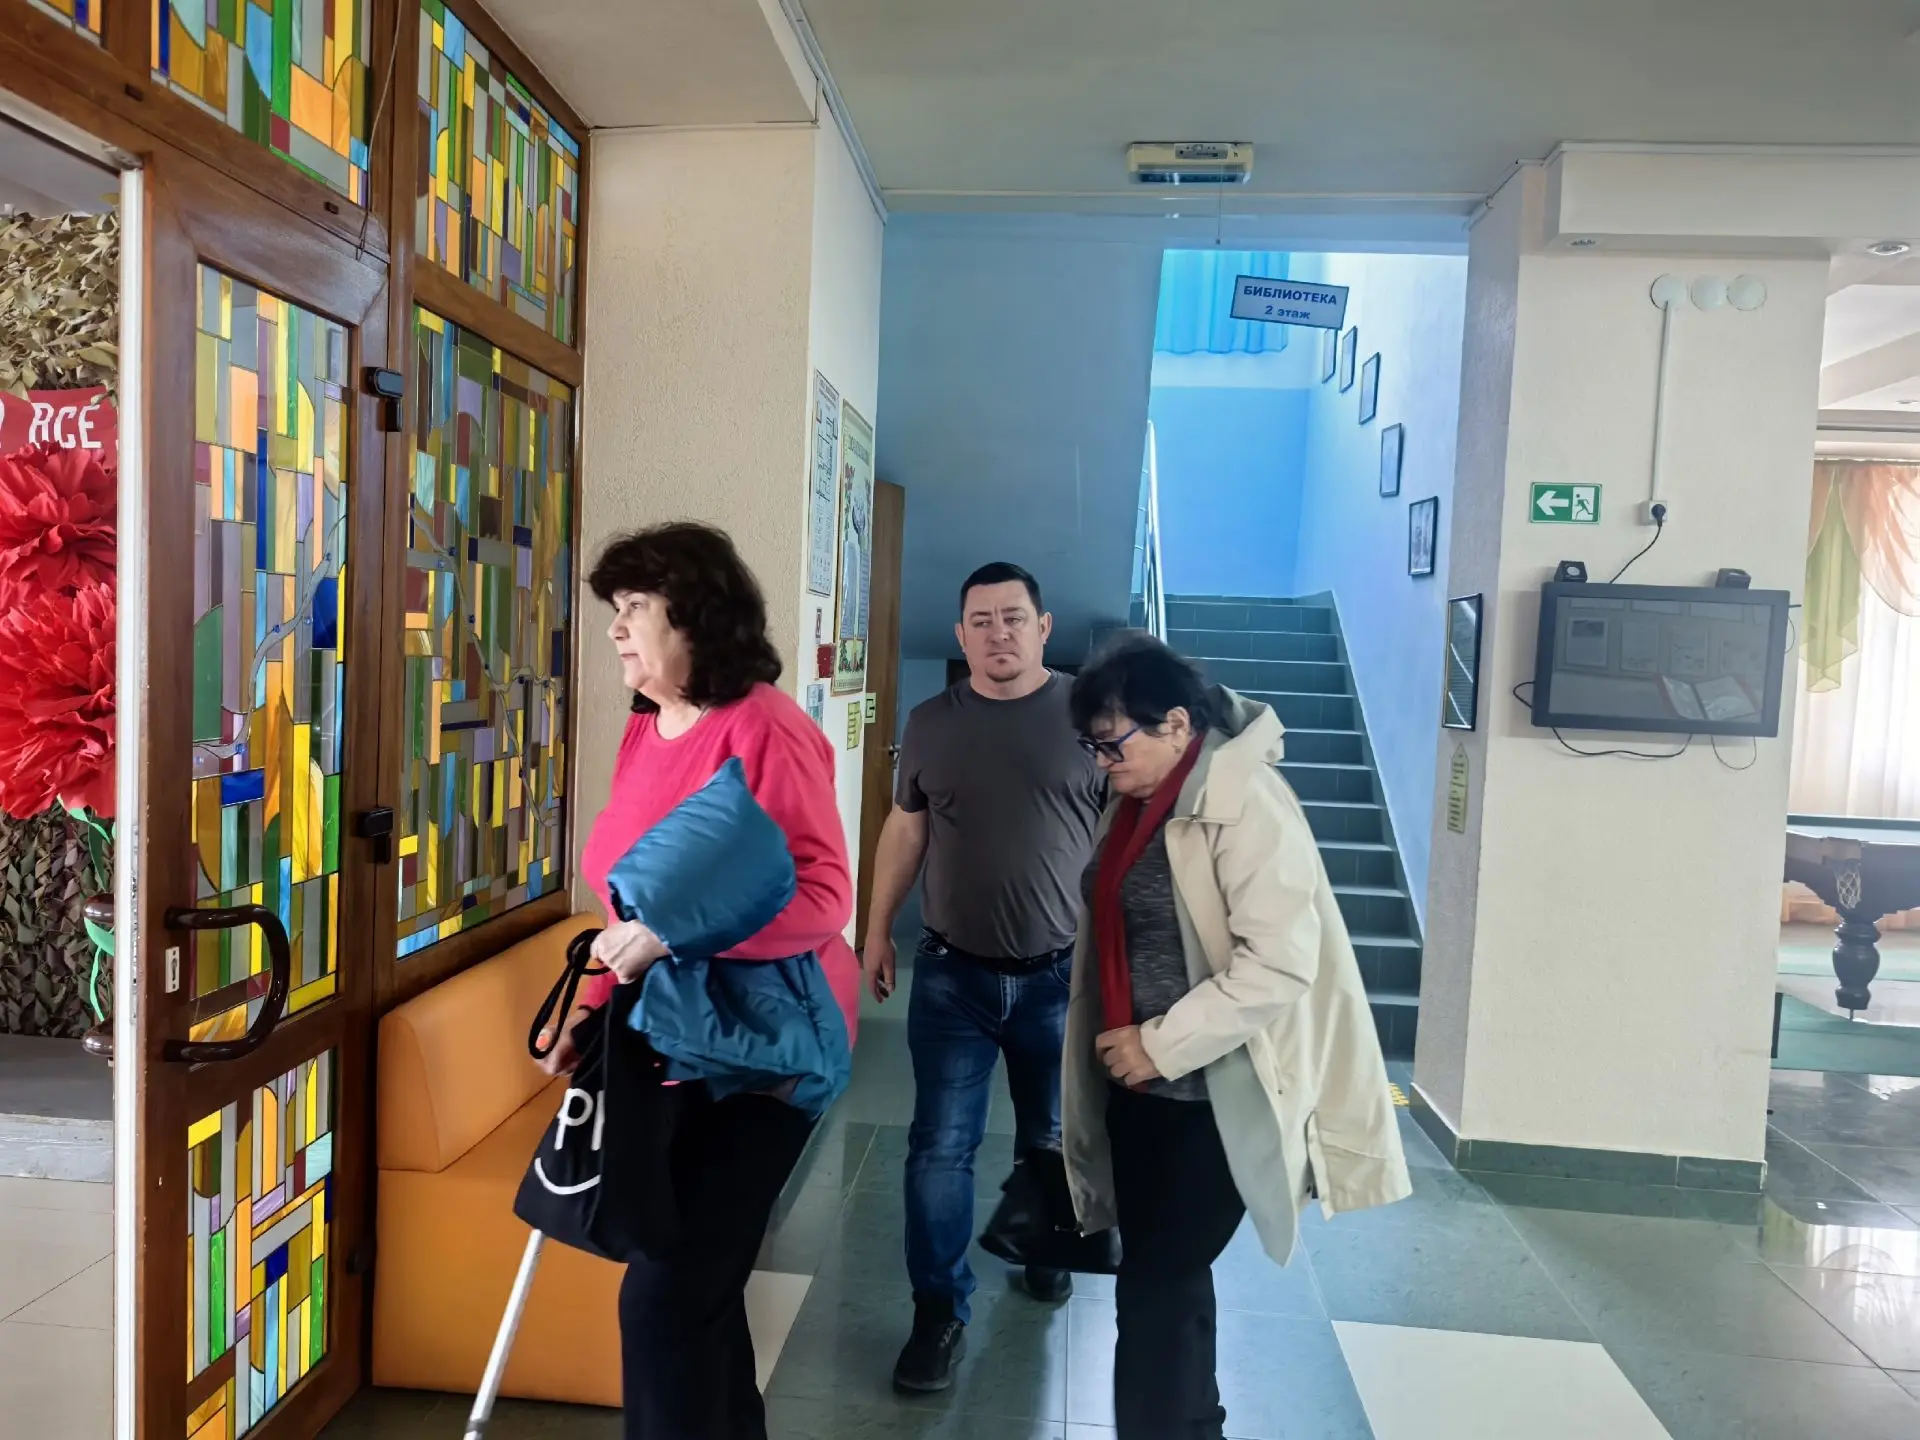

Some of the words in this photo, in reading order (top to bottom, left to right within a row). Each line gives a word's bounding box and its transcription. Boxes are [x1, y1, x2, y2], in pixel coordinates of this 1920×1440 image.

[1243, 285, 1337, 305] БИБЛИОТЕКА
[1264, 305, 1273, 315] 2
[1277, 308, 1311, 320] этаж
